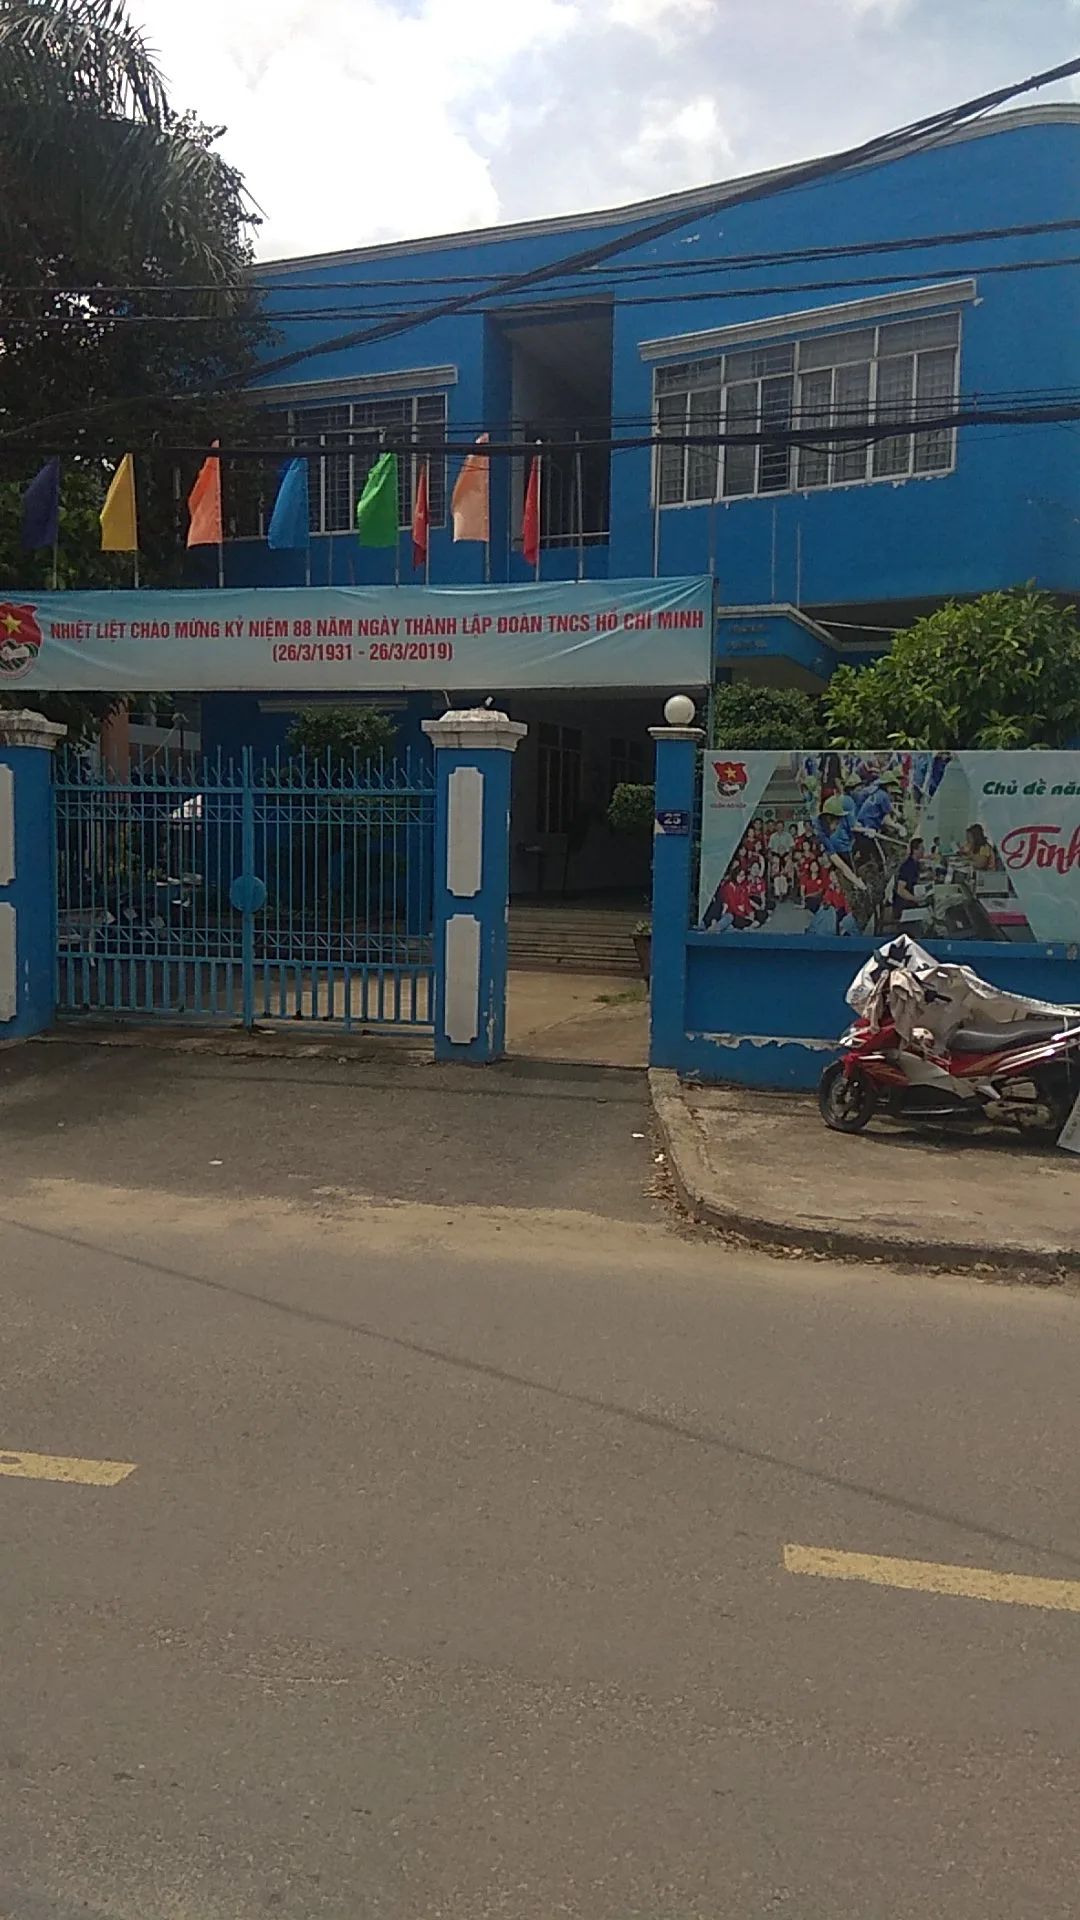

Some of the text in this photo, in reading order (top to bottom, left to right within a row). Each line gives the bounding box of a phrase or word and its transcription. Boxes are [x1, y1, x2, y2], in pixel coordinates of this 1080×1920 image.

[50, 619, 93, 643] NHIỆT
[96, 620, 126, 643] LIỆT
[130, 619, 170, 639] CHÀO
[175, 617, 220, 639] MỪNG
[249, 617, 289, 641] NIỆM
[293, 619, 311, 637] 88
[316, 616, 353, 637] NĂM
[358, 615, 400, 637] NGÀY
[404, 614, 457, 636] THÀNH
[462, 612, 493, 639] LẬP
[497, 612, 543, 634] ĐOÀN
[547, 613, 590, 632] TNCS
[657, 610, 704, 629] MINH
[272, 642, 352, 663] (26/3/1931
[369, 641, 453, 662] 26/3/2019)
[982, 779, 1019, 796] Chủ
[1022, 778, 1048, 796] đề
[663, 812, 682, 825] 25
